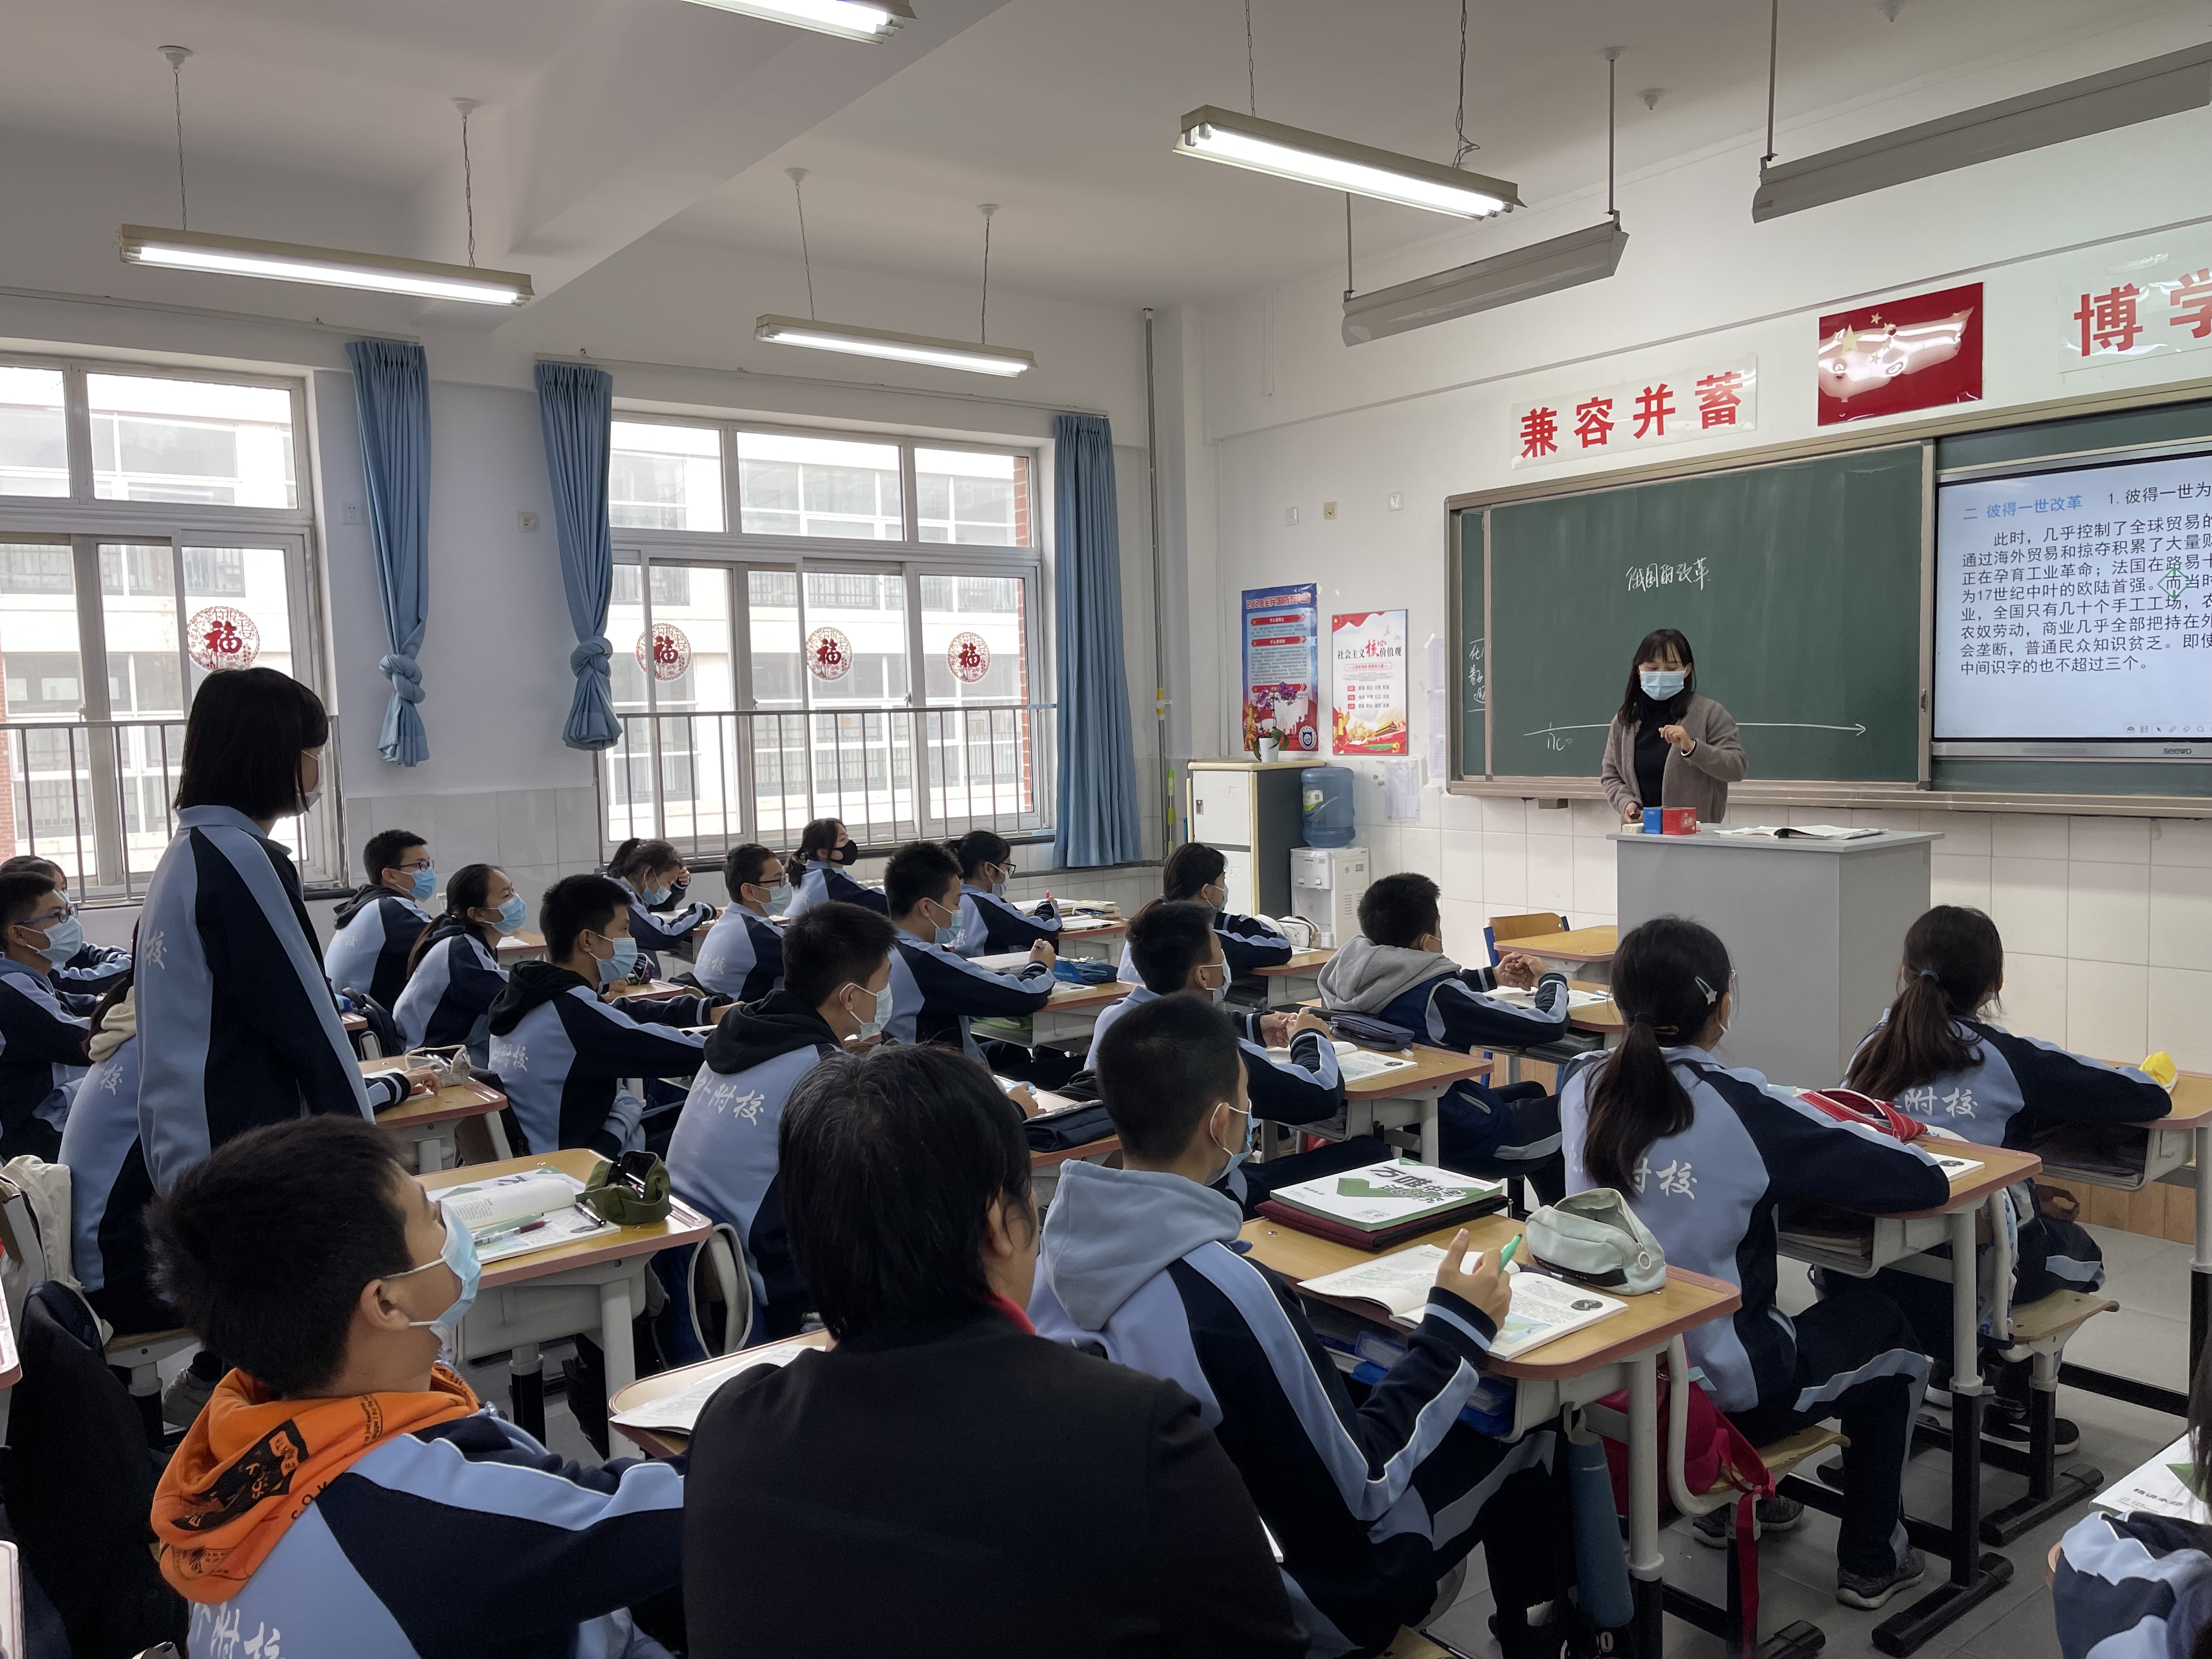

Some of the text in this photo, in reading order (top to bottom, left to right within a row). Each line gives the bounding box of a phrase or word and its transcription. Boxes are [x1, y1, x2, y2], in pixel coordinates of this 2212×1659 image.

[2074, 268, 2212, 357] 博学
[1520, 371, 1743, 459] 兼容并蓄
[1987, 495, 2083, 518] 彼得一世改革
[204, 620, 242, 653] 福
[653, 635, 679, 663] 福
[1338, 639, 1401, 659] 社会主义核心价值观
[816, 638, 842, 665] 福
[958, 642, 980, 668] 福
